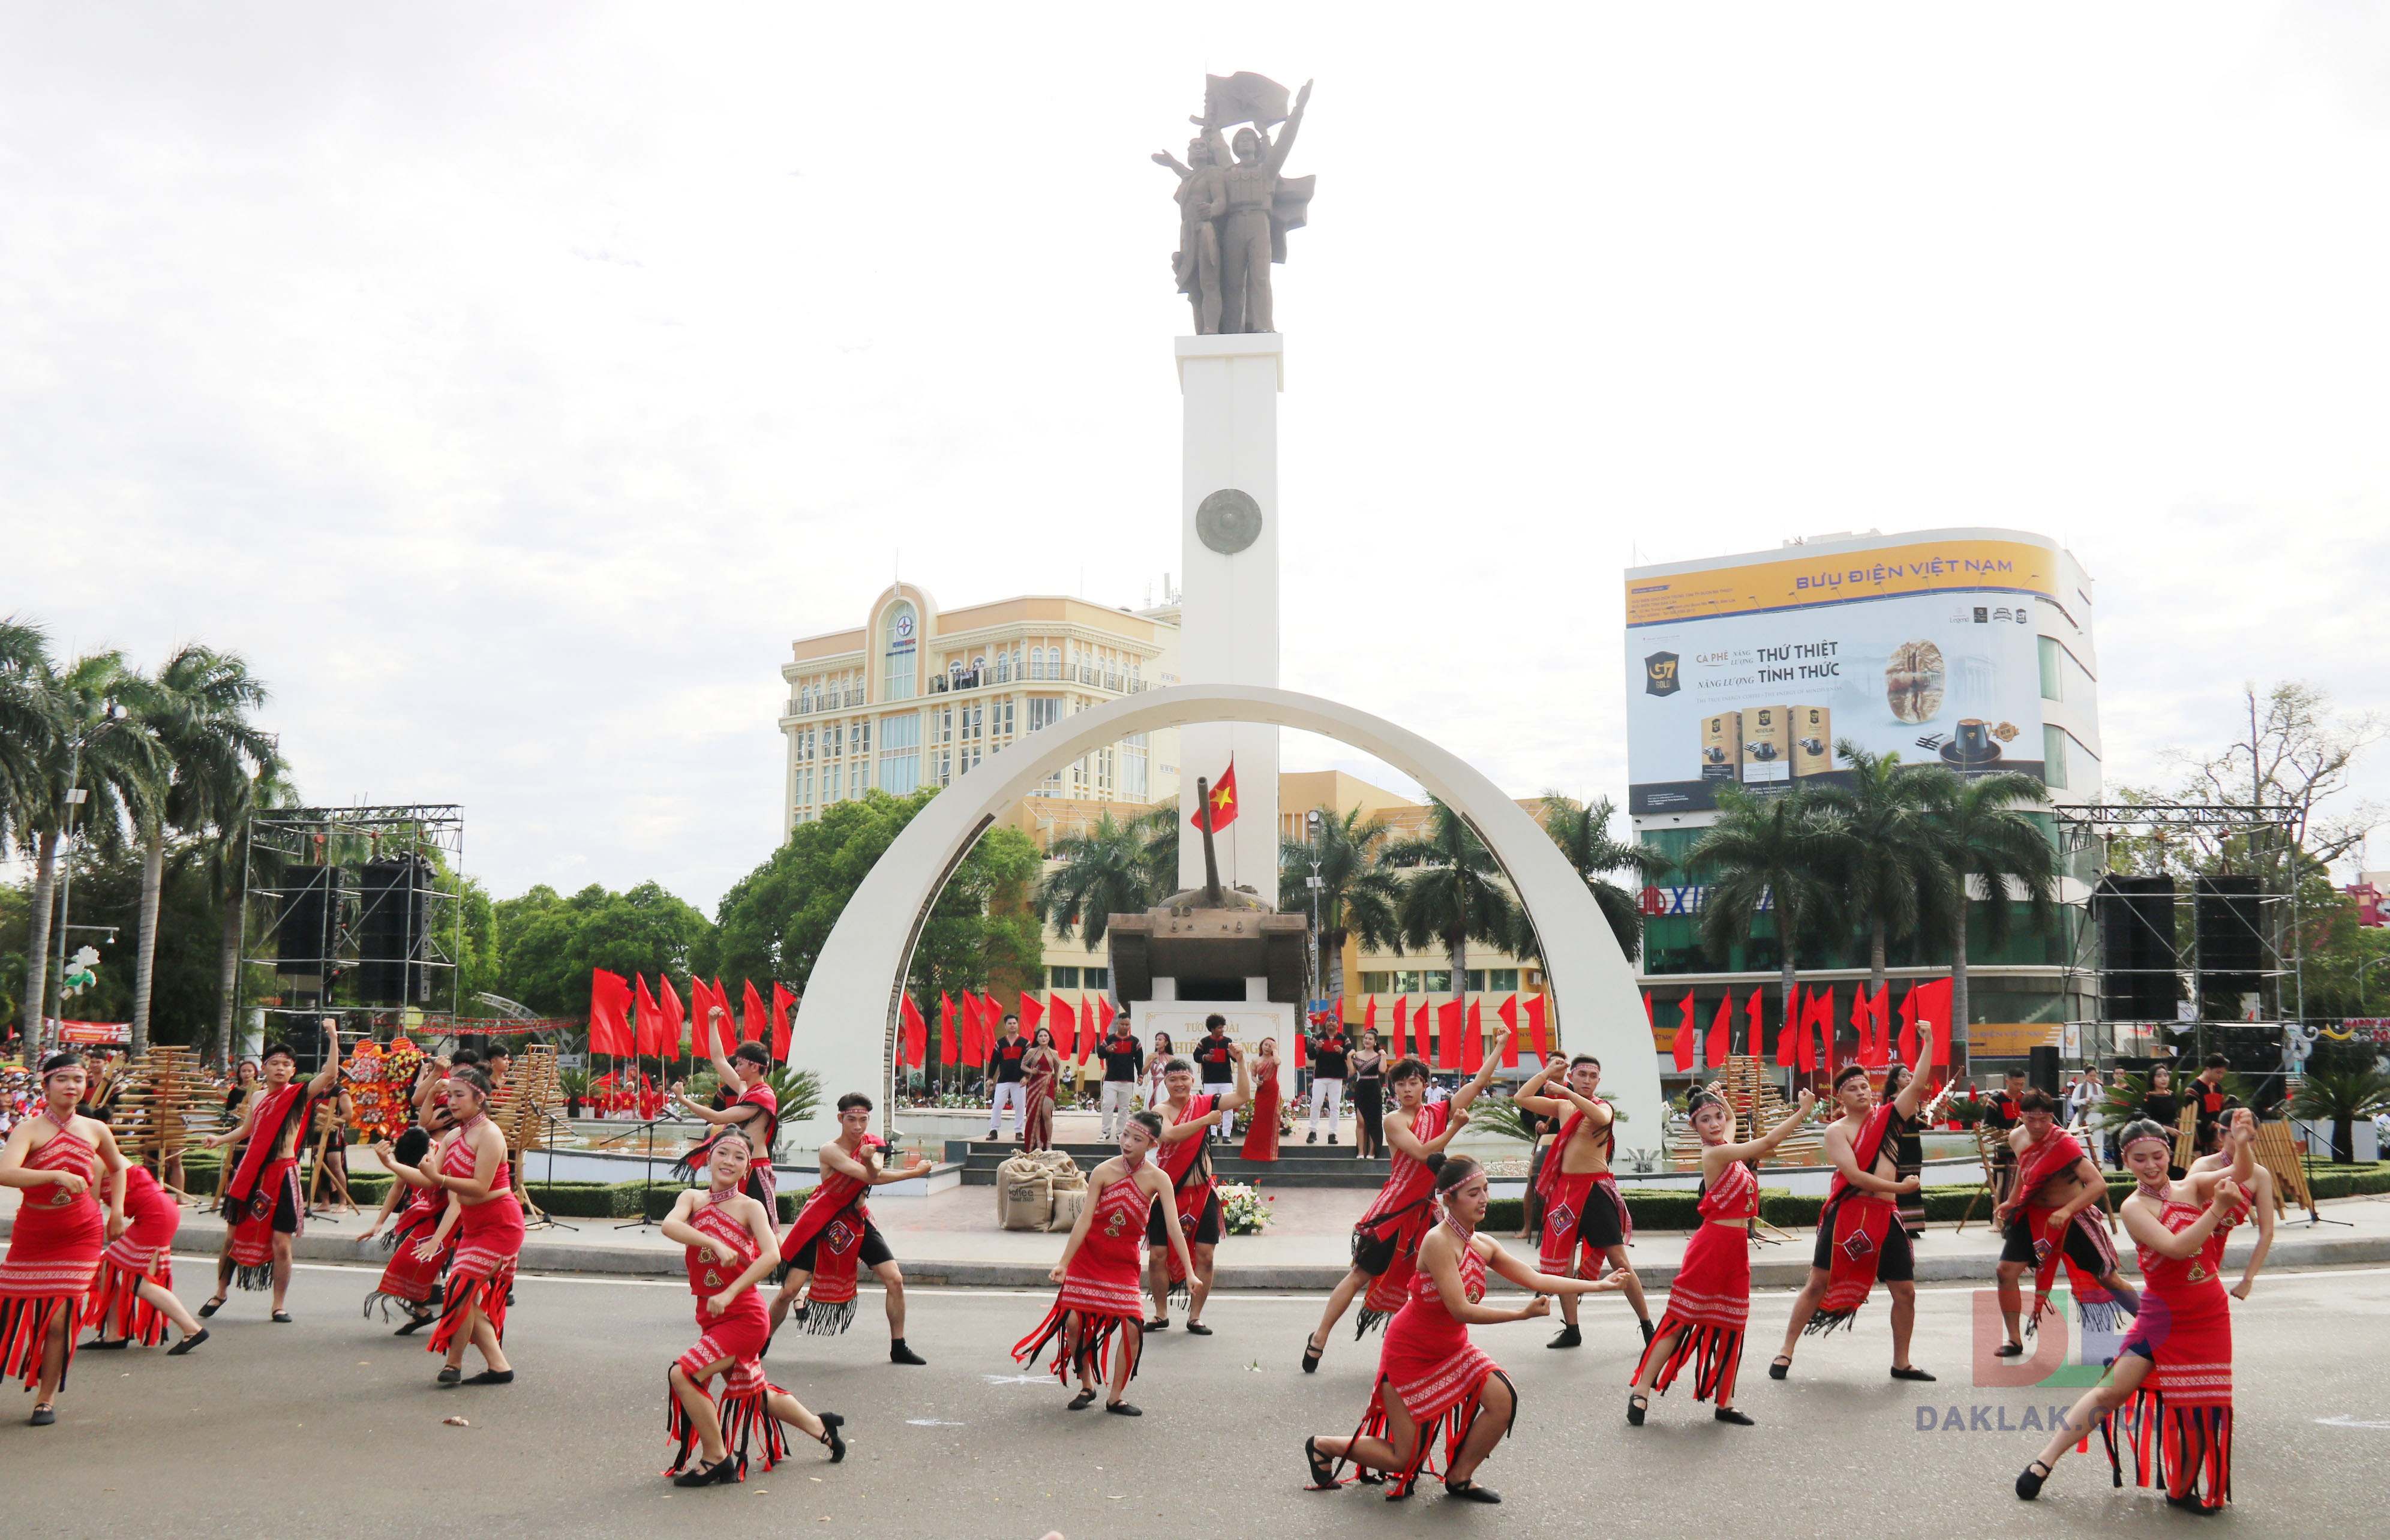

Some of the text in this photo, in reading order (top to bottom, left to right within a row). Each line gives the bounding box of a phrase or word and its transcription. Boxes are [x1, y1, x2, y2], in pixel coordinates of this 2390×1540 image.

[1796, 572, 1842, 589] BƯU
[1909, 557, 1959, 577] VIỆT
[1965, 559, 2012, 572] NAM
[1696, 651, 1728, 663] CÀ PHÊ
[1757, 640, 1838, 663] THỨ THIỆT
[1649, 661, 1676, 680] G7
[1758, 662, 1839, 683] TỈNH THỨC
[1656, 680, 1671, 689] GOLD
[1697, 676, 1755, 689] NĂNG LƯỢNG
